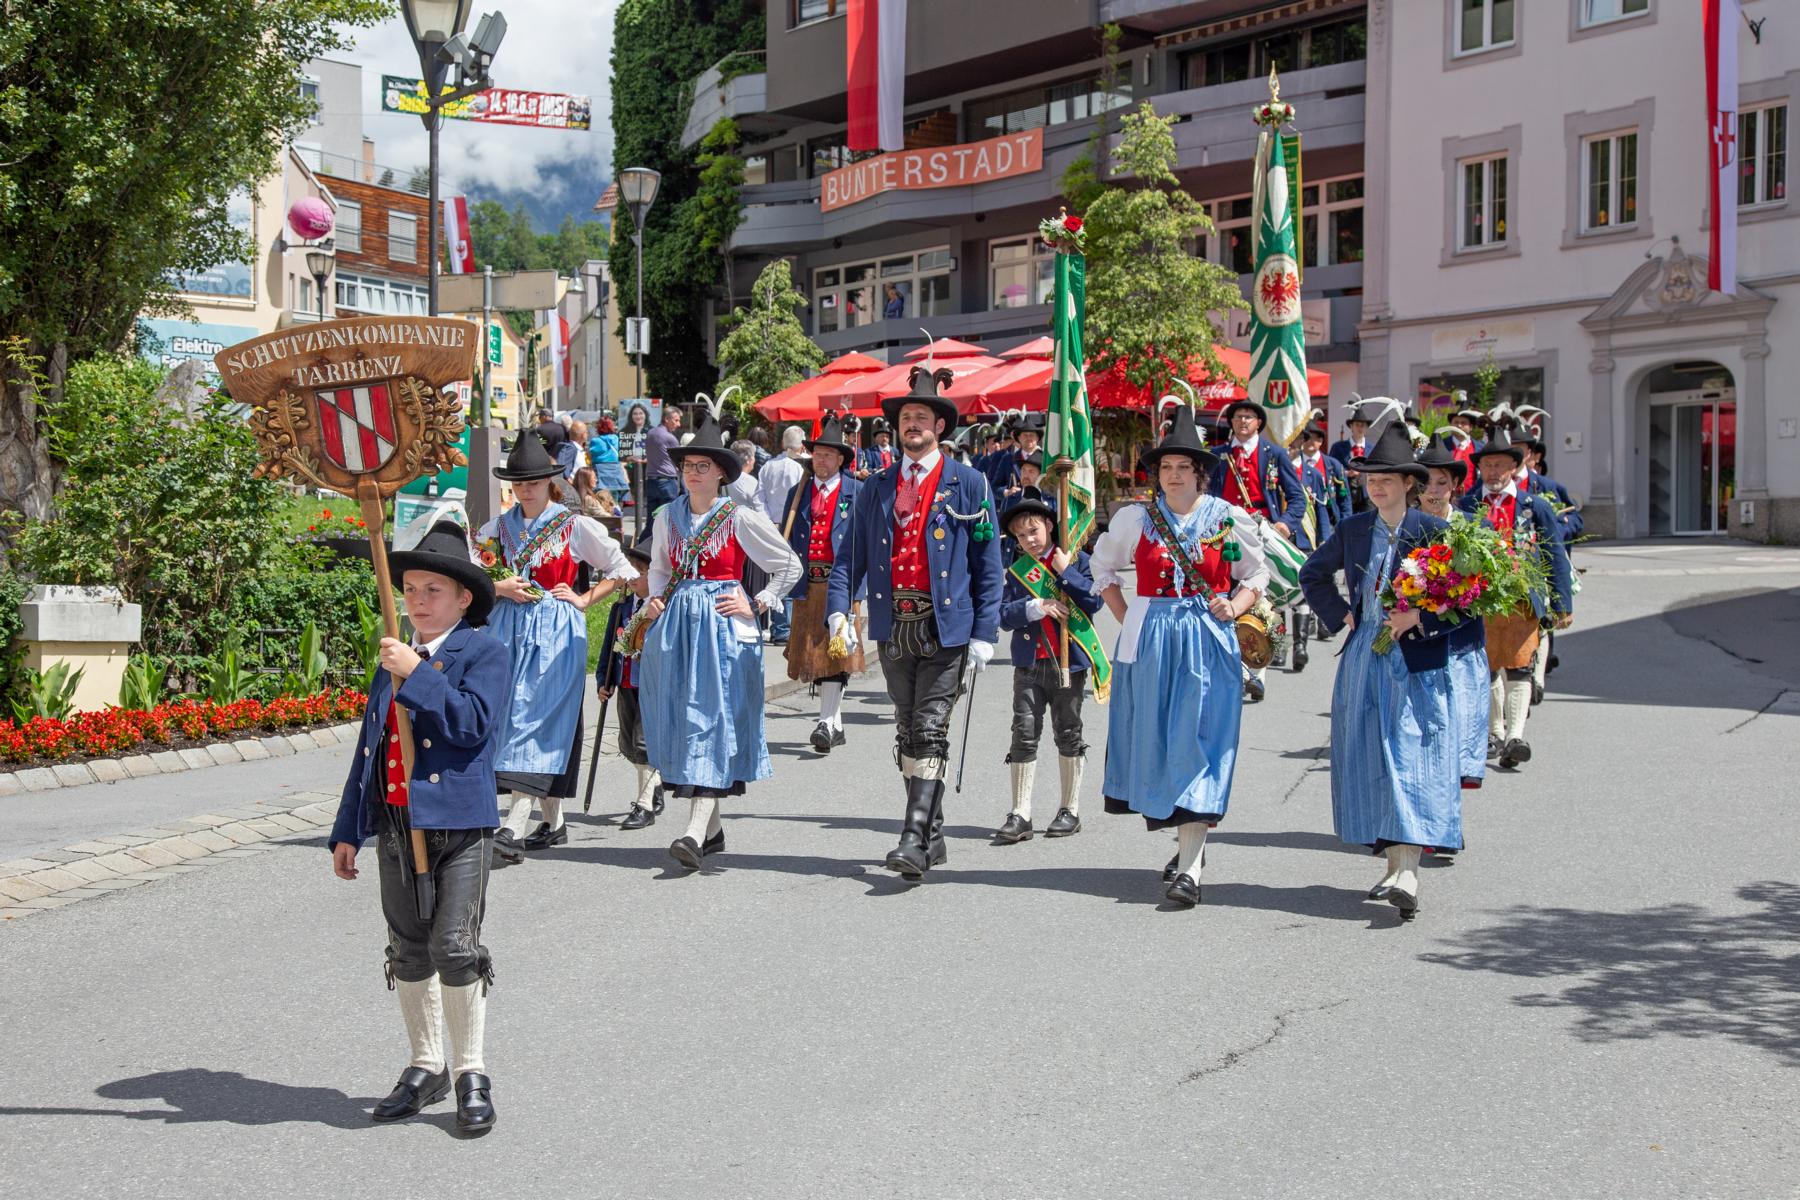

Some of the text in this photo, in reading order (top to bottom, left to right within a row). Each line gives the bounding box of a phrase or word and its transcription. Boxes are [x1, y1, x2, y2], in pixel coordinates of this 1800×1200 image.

[173, 337, 223, 355] Elektro
[292, 355, 403, 386] TARRENZ
[619, 440, 632, 448] fair
